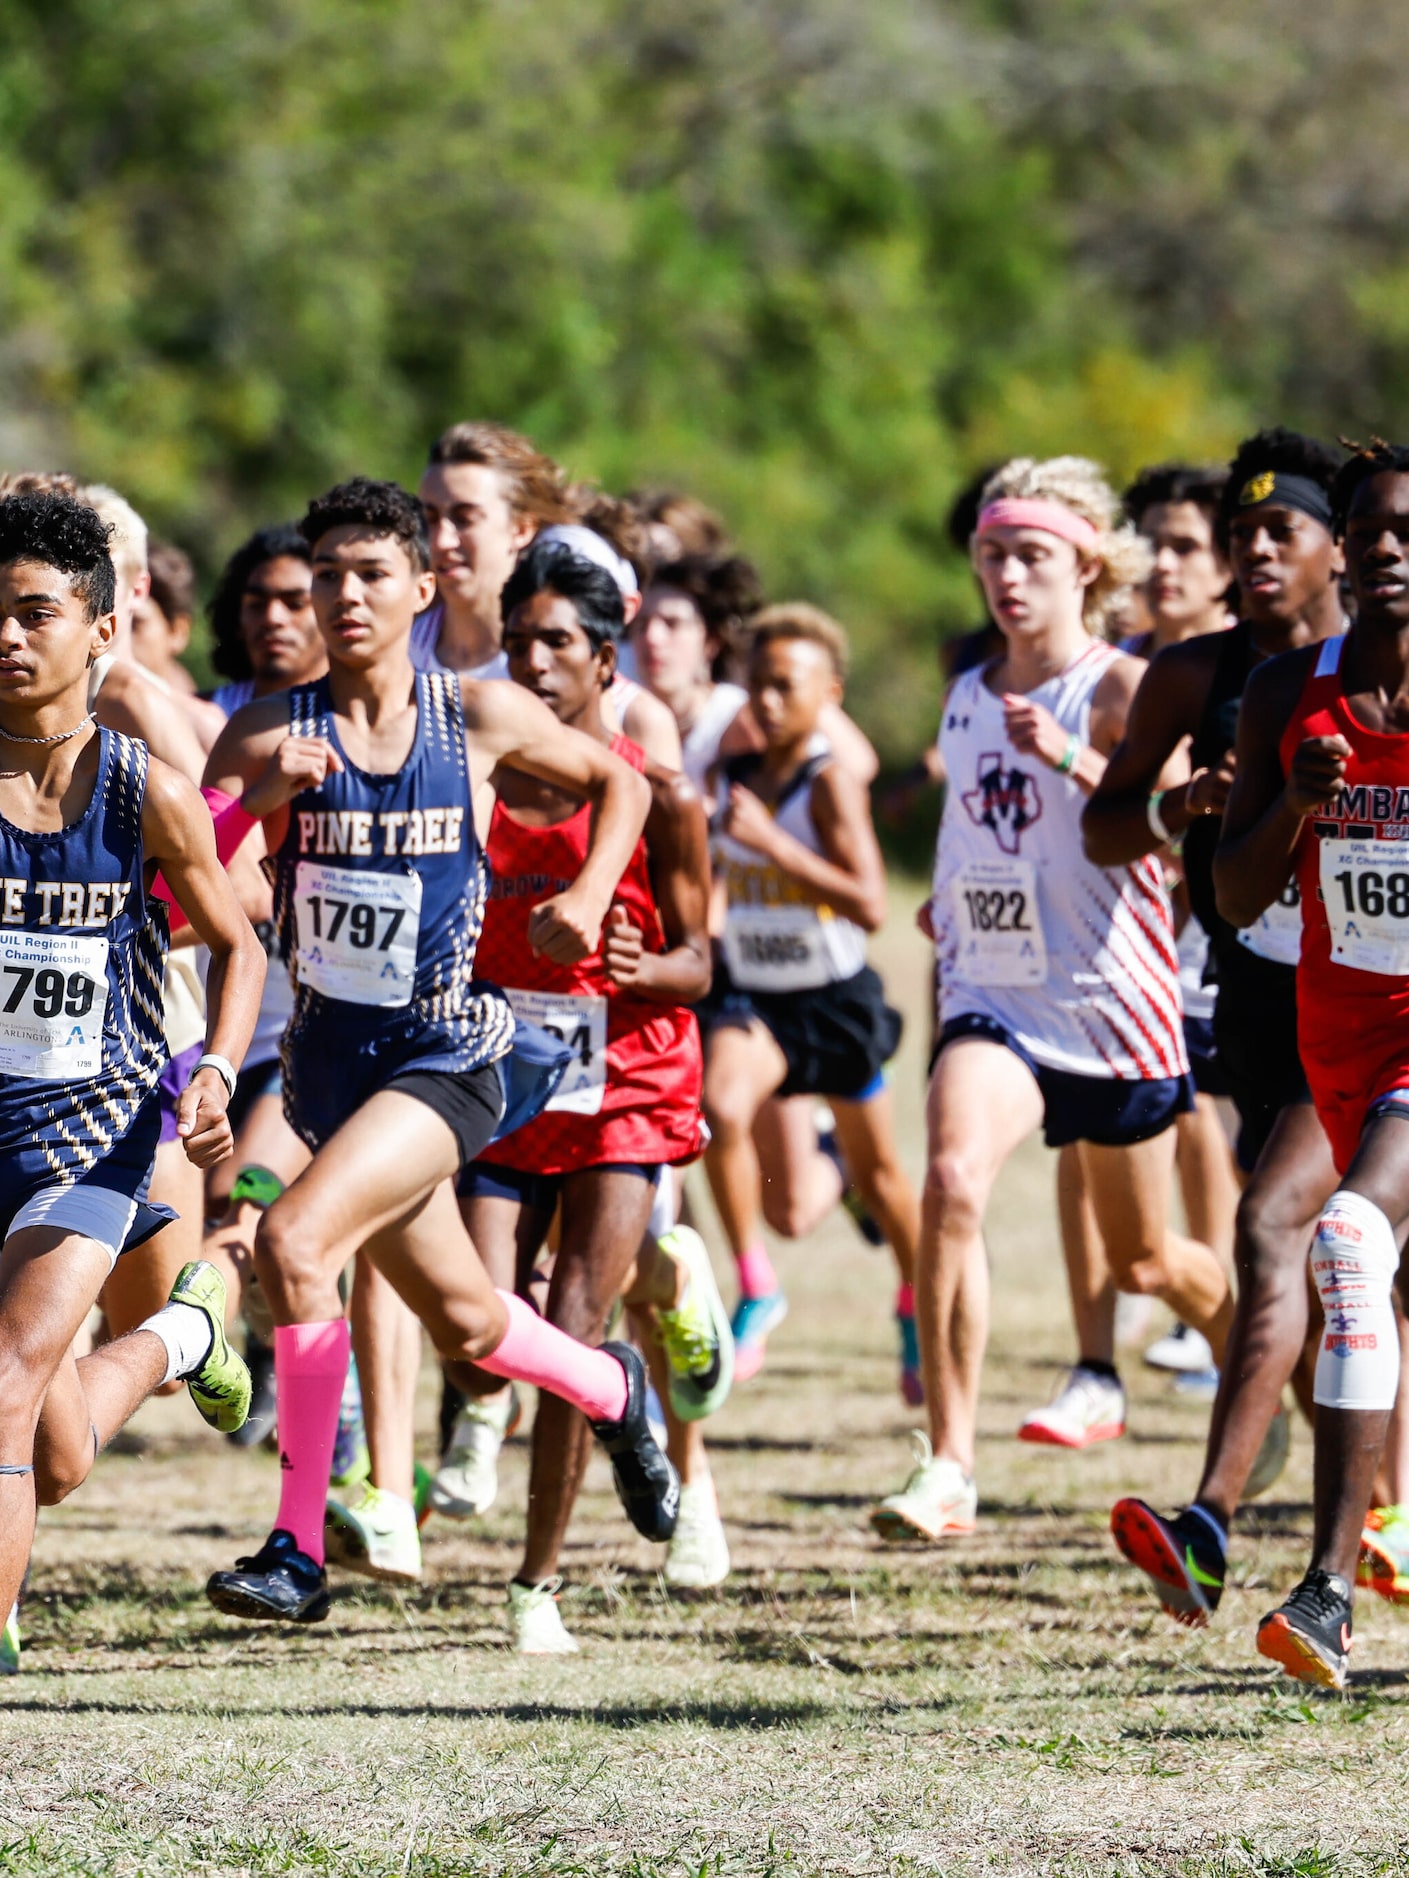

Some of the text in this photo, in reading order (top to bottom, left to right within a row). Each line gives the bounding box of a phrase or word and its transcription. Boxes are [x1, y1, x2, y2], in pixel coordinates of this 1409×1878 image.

[297, 807, 464, 856] PINE TREE
[963, 890, 1032, 933] 1822
[307, 896, 406, 952] 1797
[0, 935, 78, 949] UIL Region II
[5, 949, 91, 966] Championship
[4, 1029, 58, 1043] ARLINGTON
[76, 1060, 92, 1068] 1799
